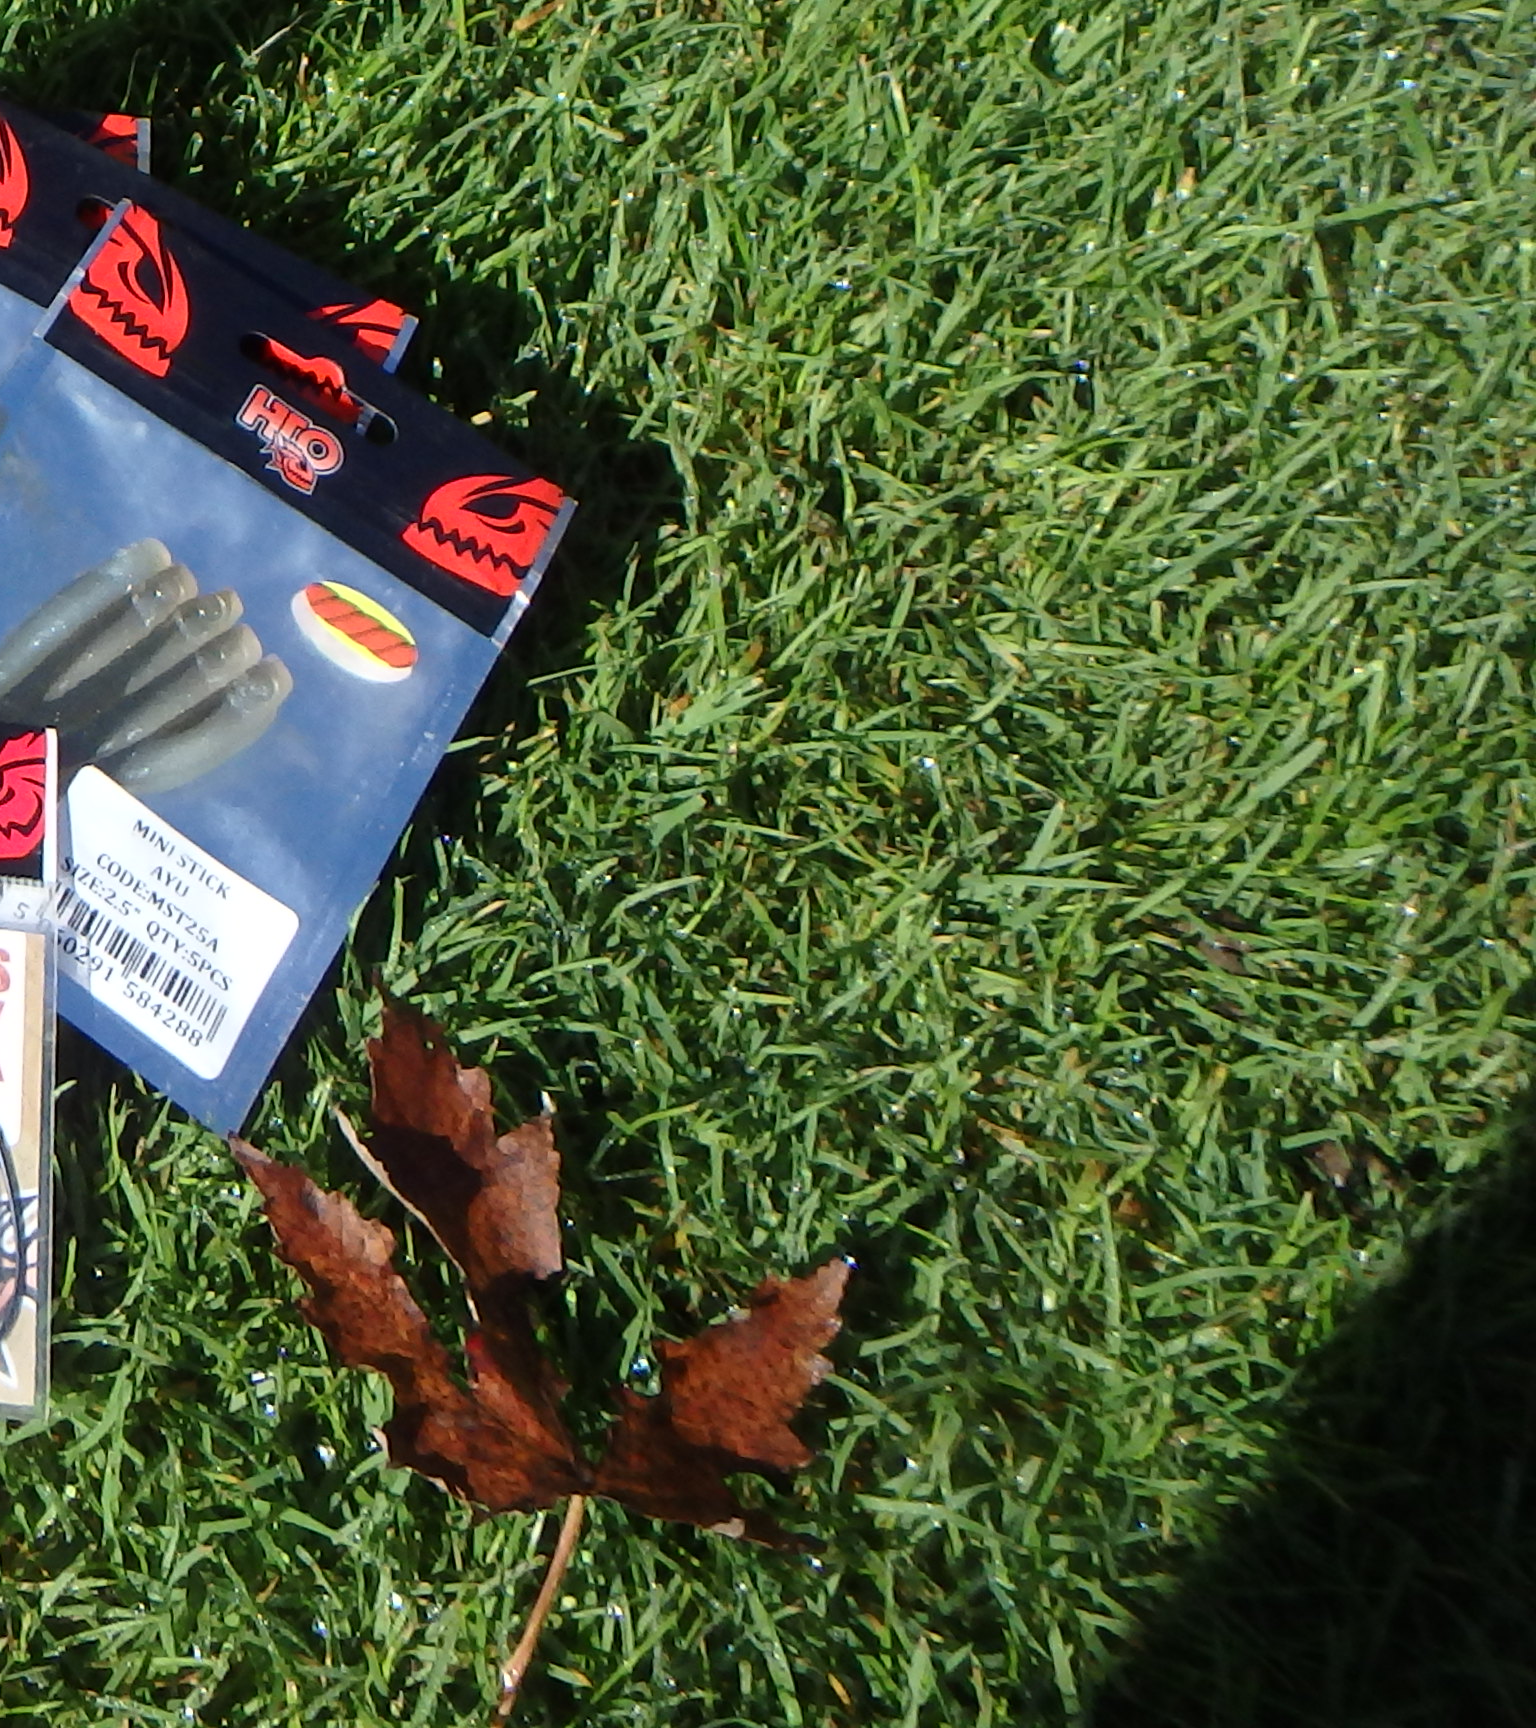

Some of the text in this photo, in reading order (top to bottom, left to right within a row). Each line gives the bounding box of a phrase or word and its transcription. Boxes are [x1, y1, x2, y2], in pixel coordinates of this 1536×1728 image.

[239, 387, 343, 475] HTO
[133, 819, 231, 900] MINI STICK
[150, 865, 190, 899] AYU
[96, 853, 219, 954] CODE:MST25A
[13, 902, 30, 919] 5
[123, 982, 204, 1048] 584288
[146, 920, 234, 992] QTY:5PCS
